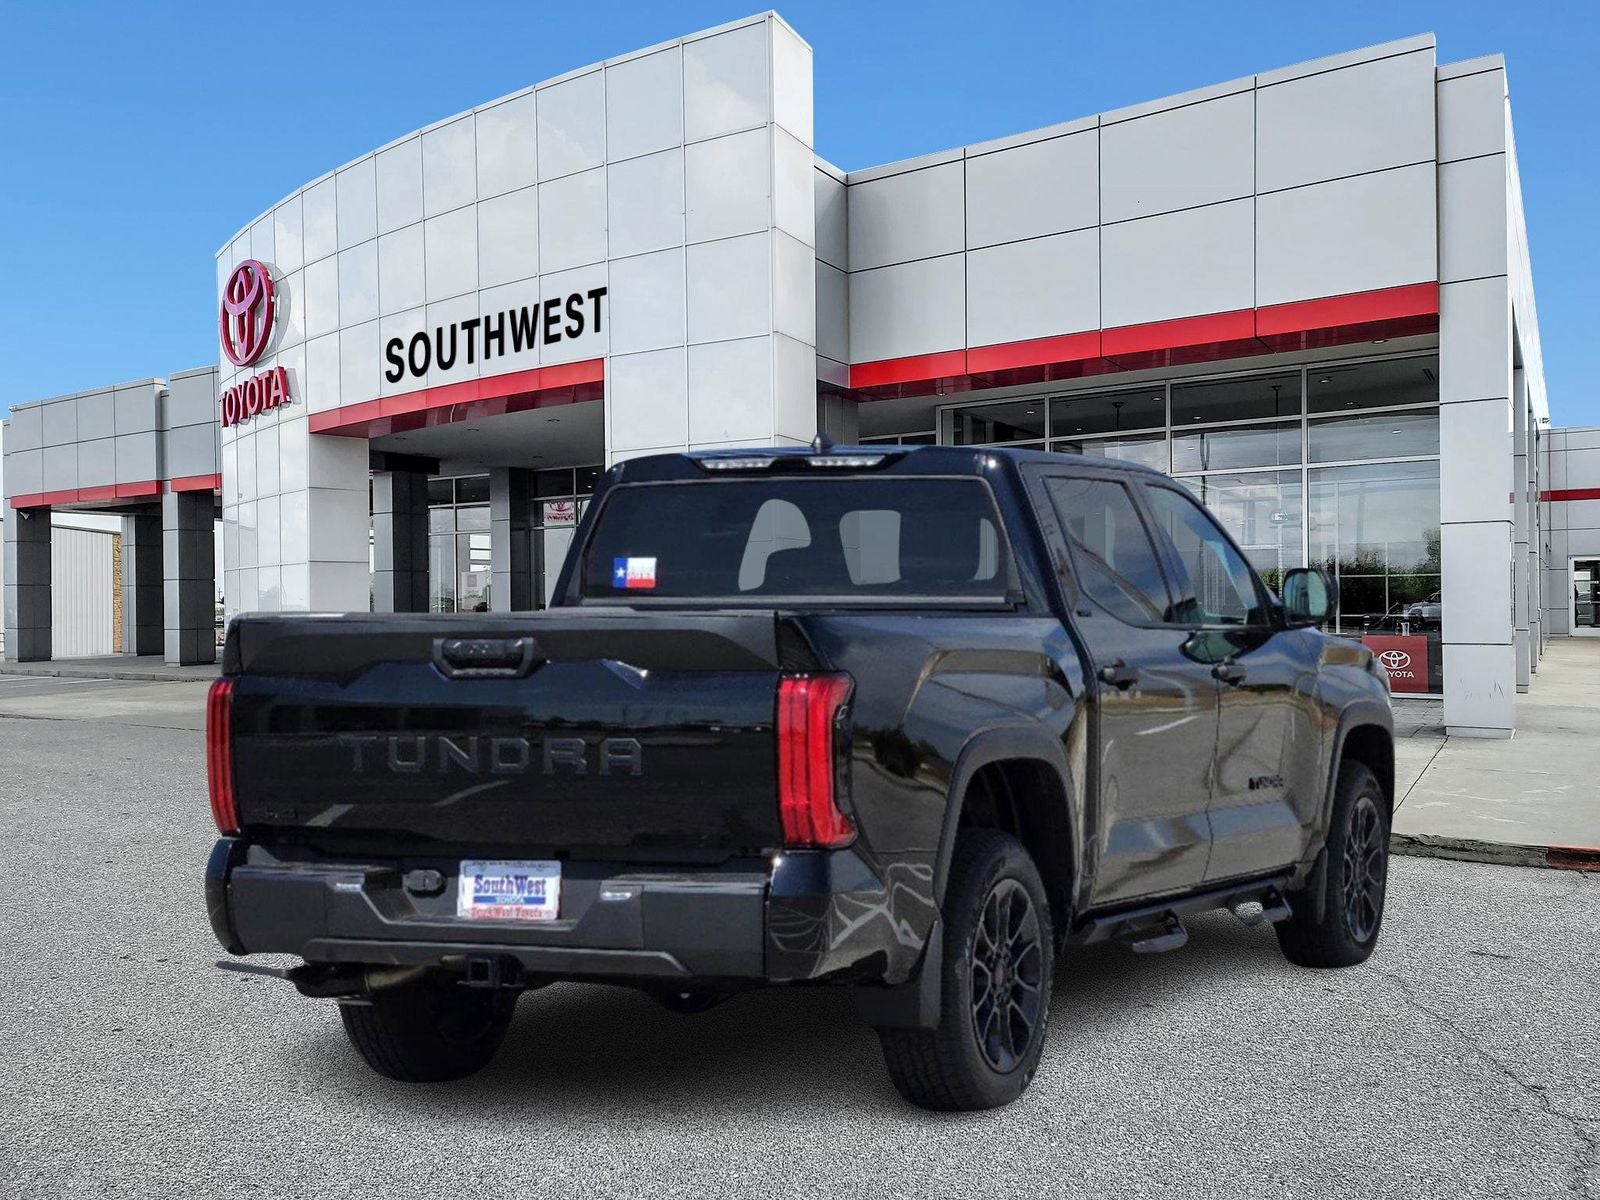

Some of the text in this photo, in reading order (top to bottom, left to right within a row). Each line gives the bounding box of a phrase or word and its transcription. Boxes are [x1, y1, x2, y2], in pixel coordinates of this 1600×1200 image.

[385, 286, 608, 384] SOUTHWEST
[219, 366, 290, 428] TOYOTA
[1386, 670, 1415, 678] YOTA
[336, 735, 642, 775] TUNDRA
[473, 874, 546, 895] SouthWest
